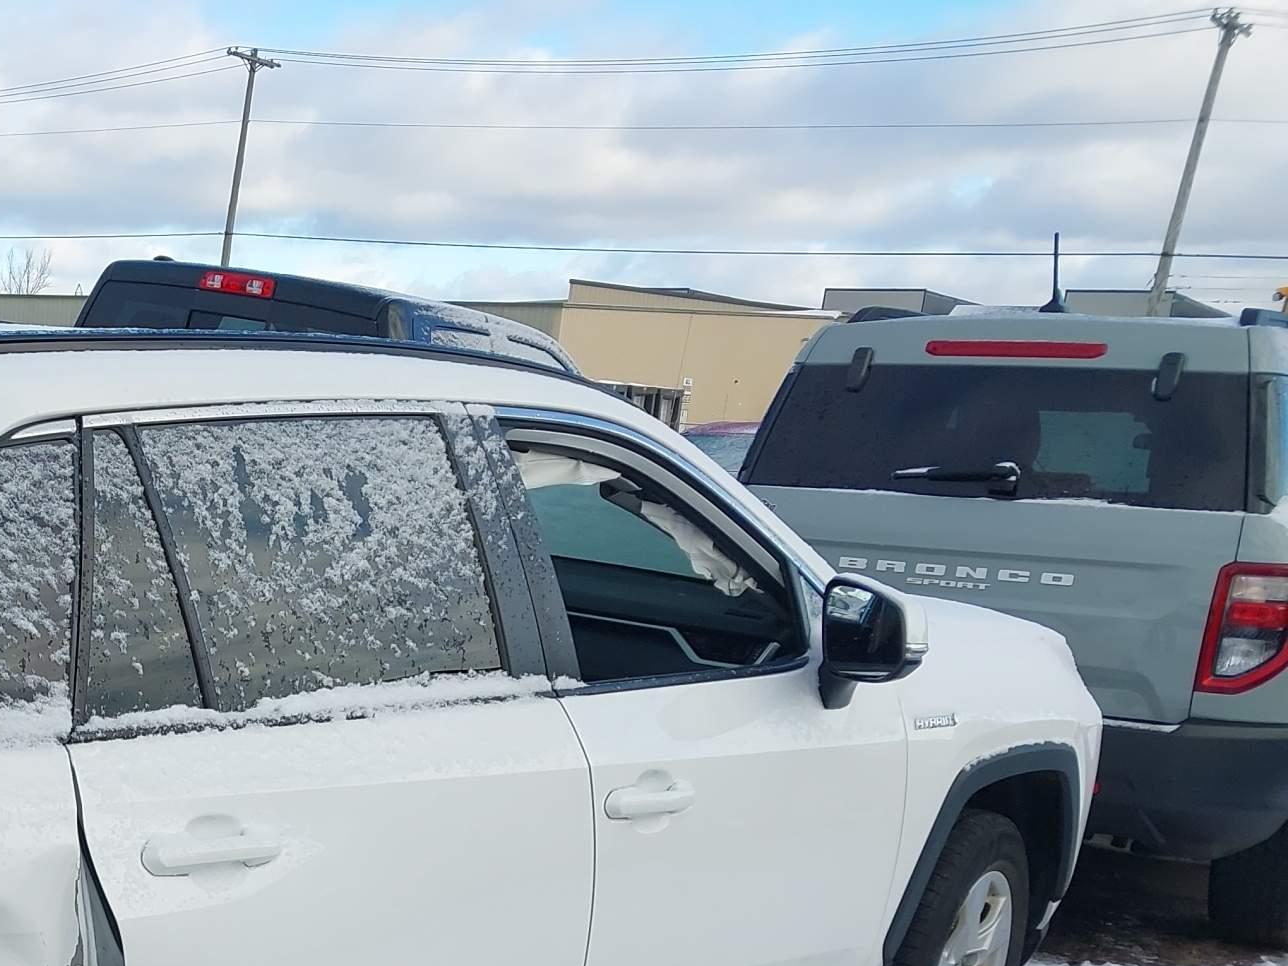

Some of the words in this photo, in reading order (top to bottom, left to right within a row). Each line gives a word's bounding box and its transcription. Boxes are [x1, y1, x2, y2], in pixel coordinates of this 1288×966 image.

[839, 556, 1075, 586] BRONCO
[906, 577, 991, 590] SPORT
[914, 713, 957, 730] HYBRID
